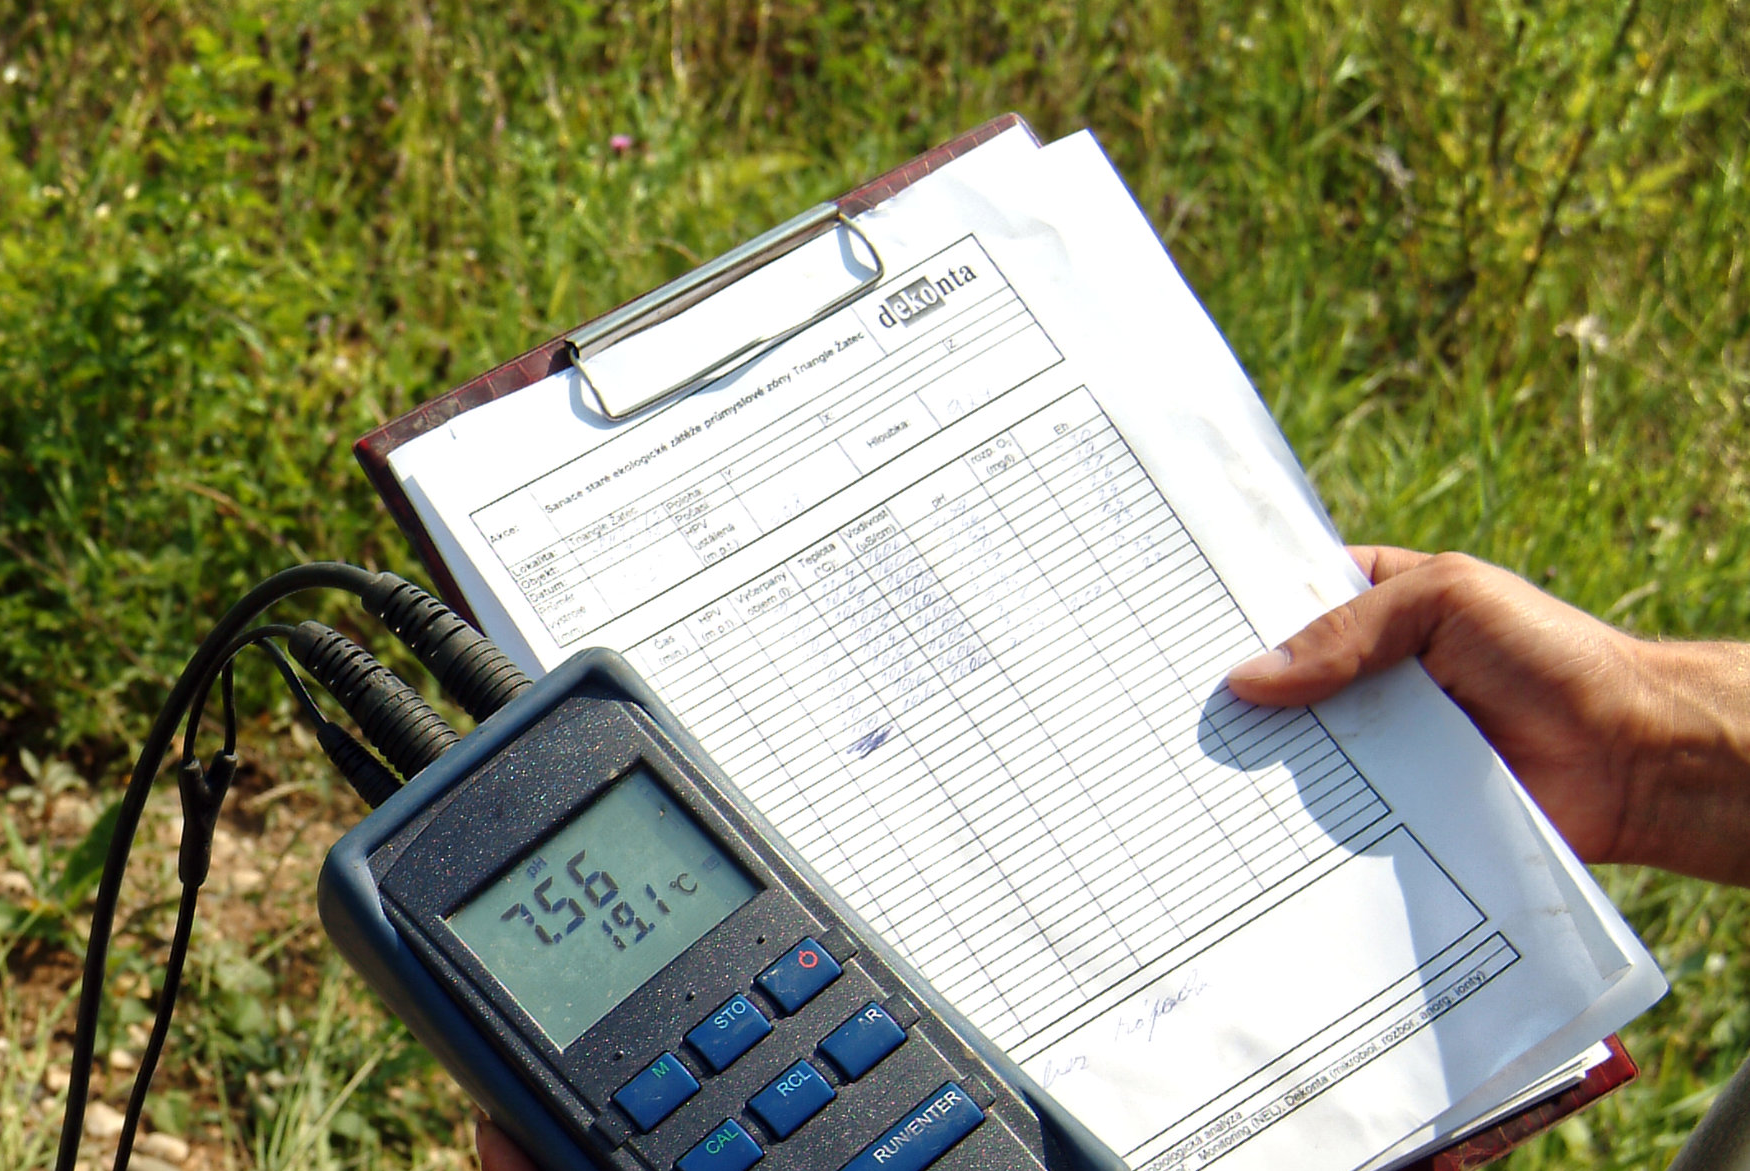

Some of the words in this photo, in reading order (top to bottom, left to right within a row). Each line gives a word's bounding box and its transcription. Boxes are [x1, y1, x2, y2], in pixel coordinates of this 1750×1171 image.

[875, 264, 978, 330] dekonta
[544, 489, 585, 515] Sanace
[489, 525, 519, 546] Akce:
[526, 856, 550, 879] pH
[713, 1001, 747, 1031] STO
[650, 1060, 671, 1079] M
[776, 1068, 812, 1098] RCL
[871, 1088, 962, 1165] RUN/ENTER
[1195, 1124, 1253, 1162] Monitoring
[1283, 1075, 1331, 1108] Dekonta
[1202, 1111, 1244, 1141] analýza
[705, 1127, 740, 1157] CAL
